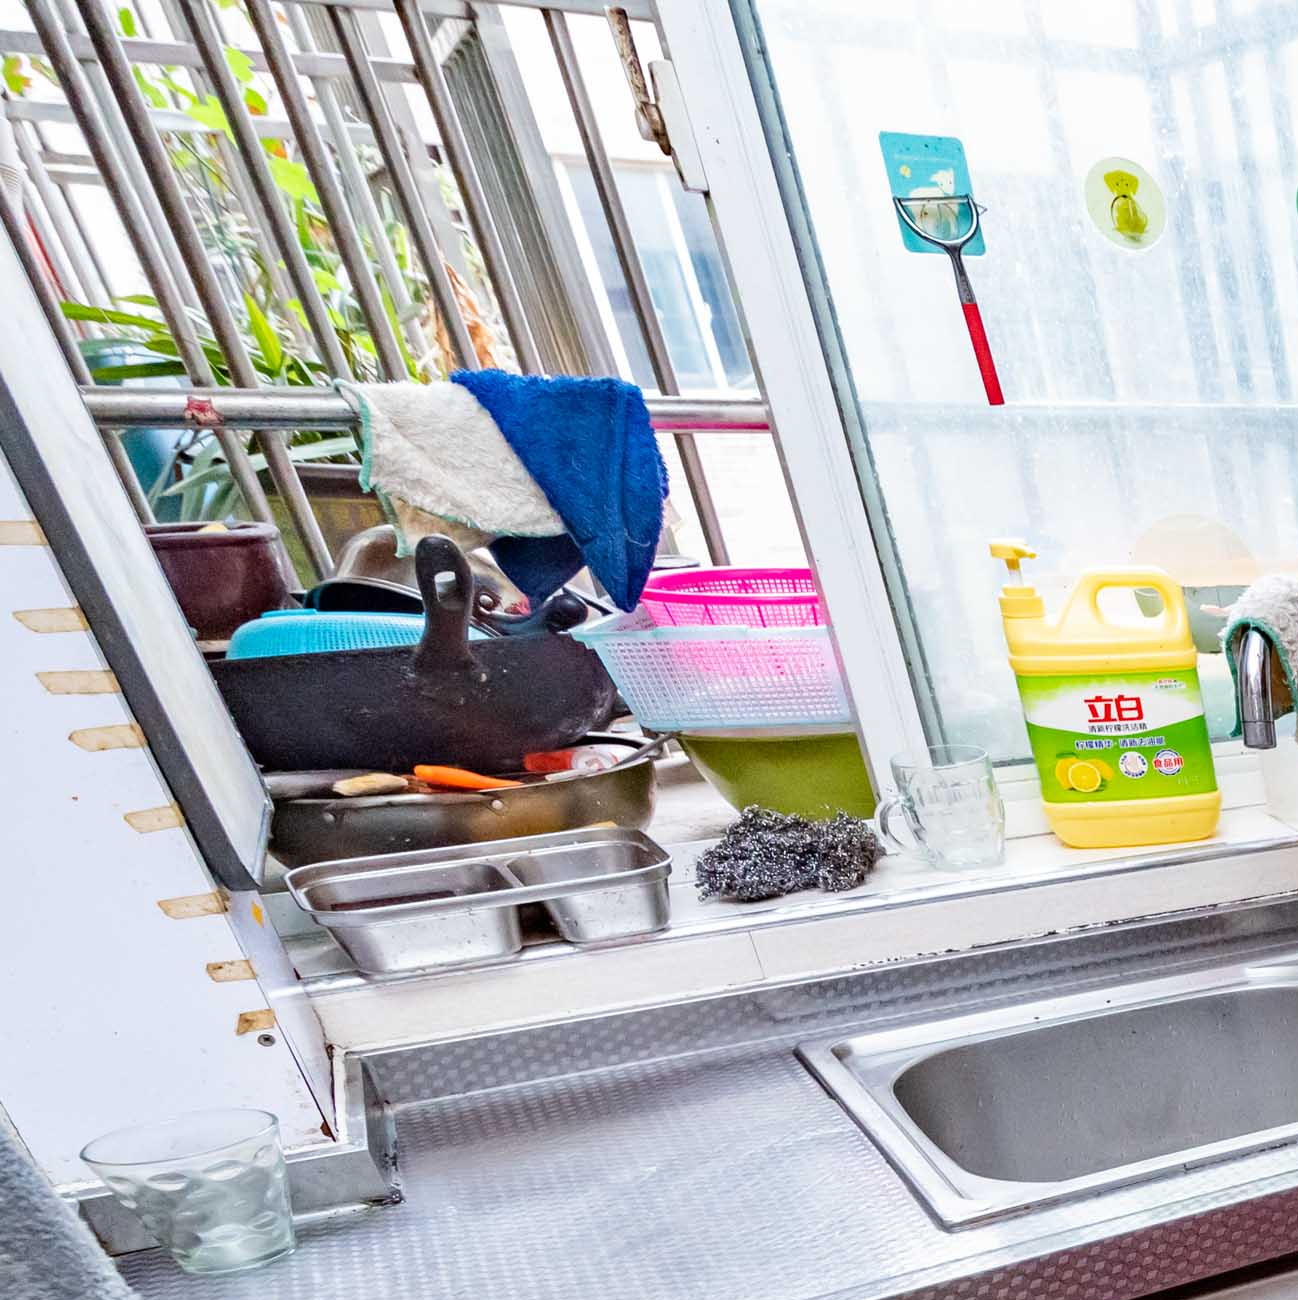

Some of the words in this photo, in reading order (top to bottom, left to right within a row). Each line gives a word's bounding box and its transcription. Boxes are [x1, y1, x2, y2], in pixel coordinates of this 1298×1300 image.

[1084, 694, 1144, 723] 立白
[1153, 757, 1184, 769] 食品用
